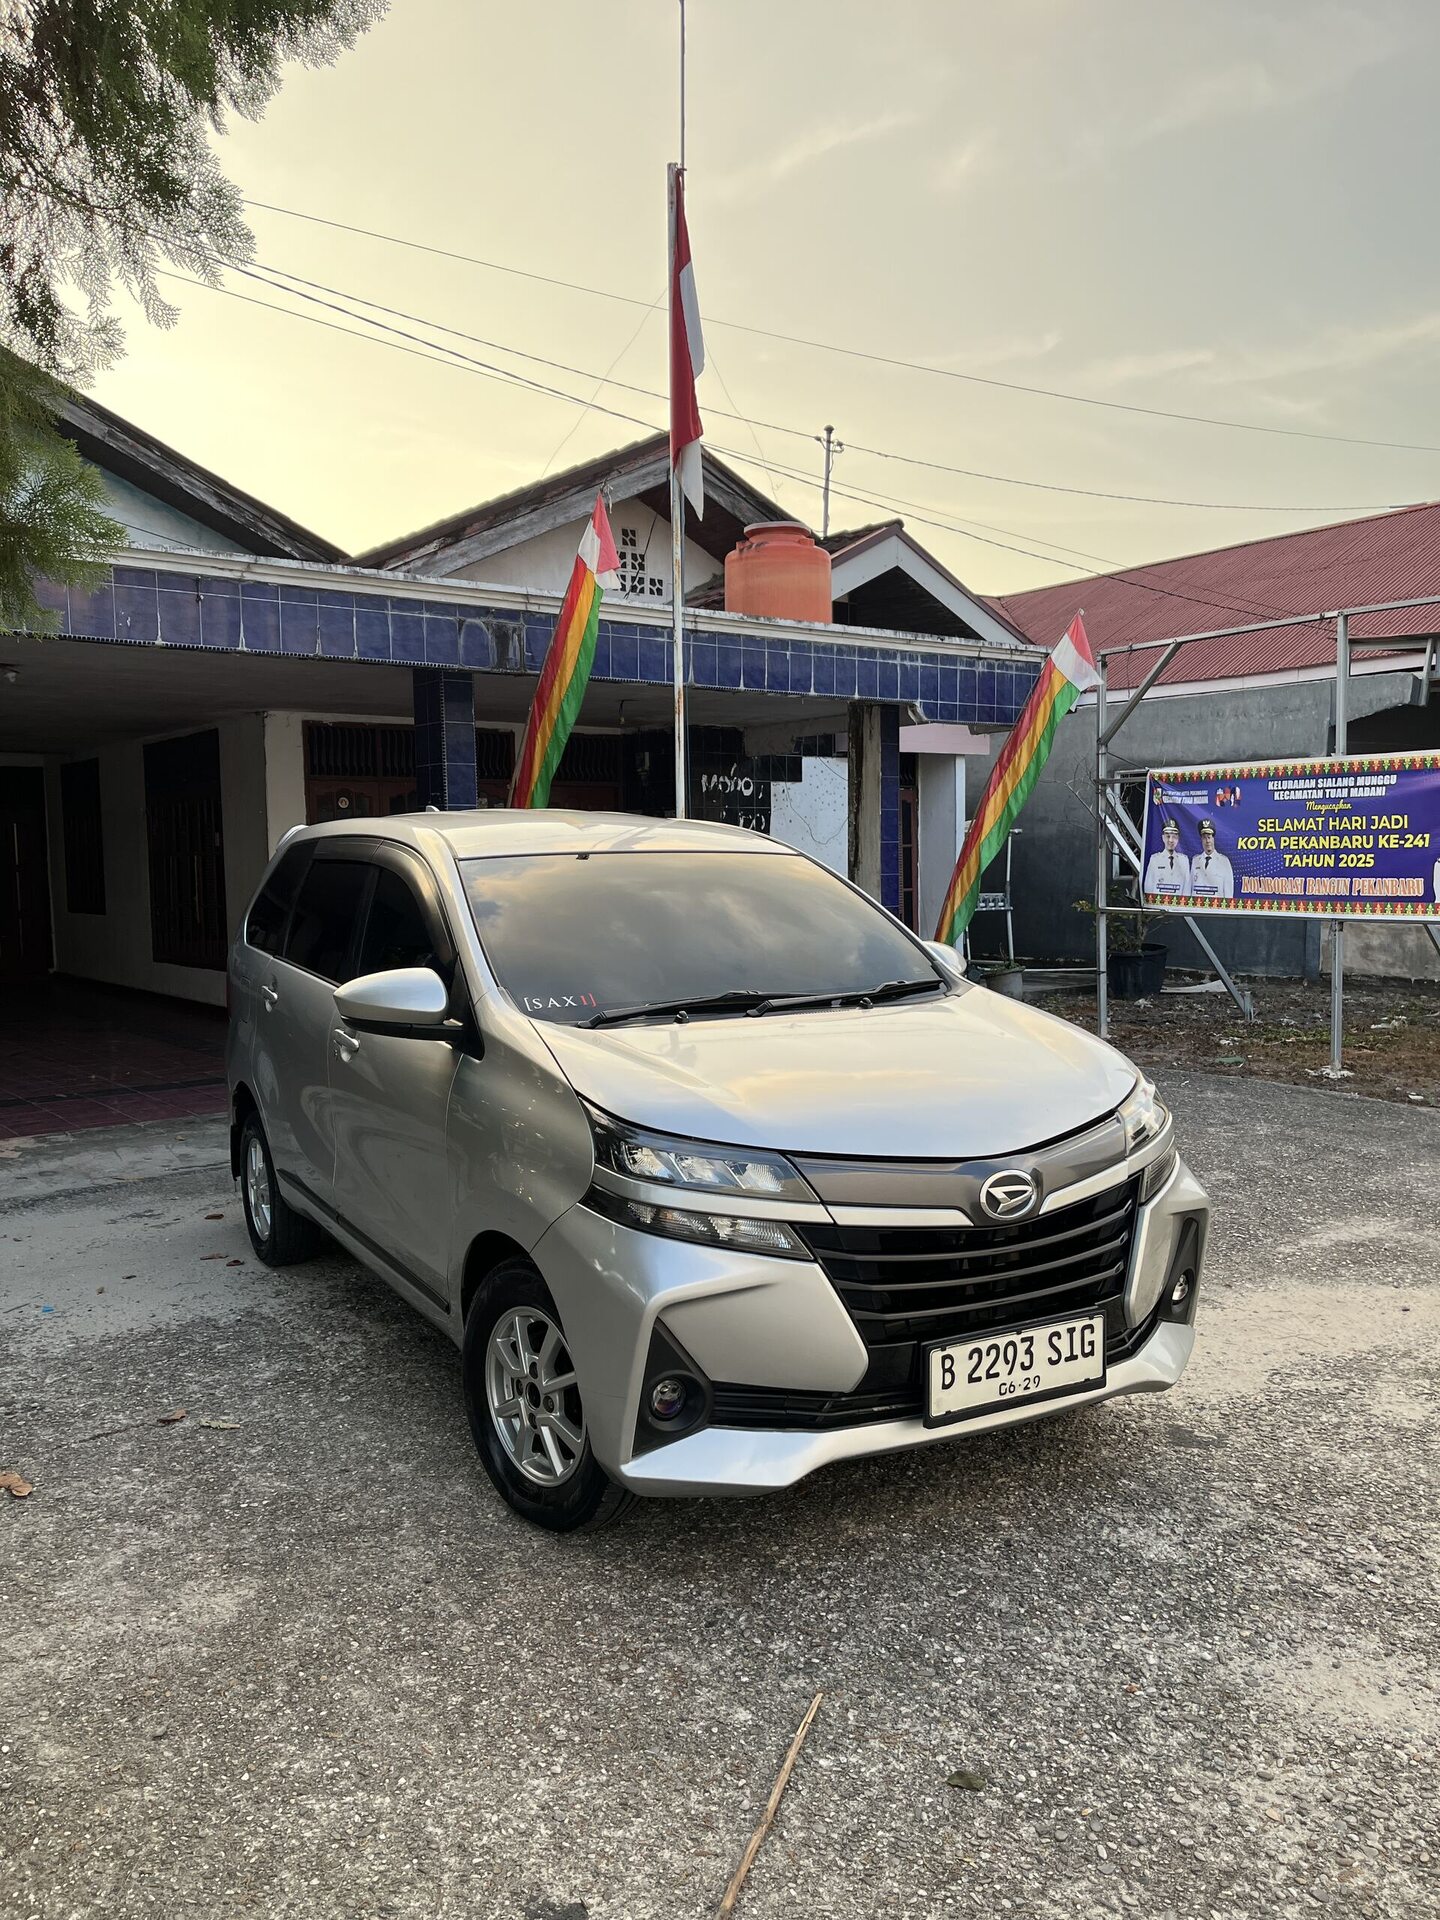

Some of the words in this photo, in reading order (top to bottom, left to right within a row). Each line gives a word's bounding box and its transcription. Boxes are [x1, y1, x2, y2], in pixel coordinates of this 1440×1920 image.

[1267, 780, 1316, 790] KELURAHAN
[1317, 777, 1355, 788] SIALANG
[1356, 774, 1397, 786] MUNGGU
[1274, 790, 1323, 800] KECAMATAN
[1324, 788, 1348, 798] TUAH
[1349, 786, 1386, 797] MADANI
[1305, 799, 1352, 815] Mengucapkan
[1257, 817, 1325, 833] SELAMAT
[1328, 816, 1366, 831] HARI
[1370, 814, 1408, 830] JADI
[1237, 837, 1276, 850] KOTA
[1280, 835, 1373, 850] PEKANBARU
[1377, 833, 1430, 848] KE-241
[1283, 854, 1335, 868] TAHUN
[1338, 853, 1375, 868] 2025
[1241, 876, 1304, 894] KOLABORASI
[1306, 877, 1350, 896] BANGUN
[1351, 877, 1424, 896] PEKANBARU
[941, 1353, 955, 1390] B
[967, 1335, 1034, 1384] 2293
[1047, 1323, 1095, 1366] SIG
